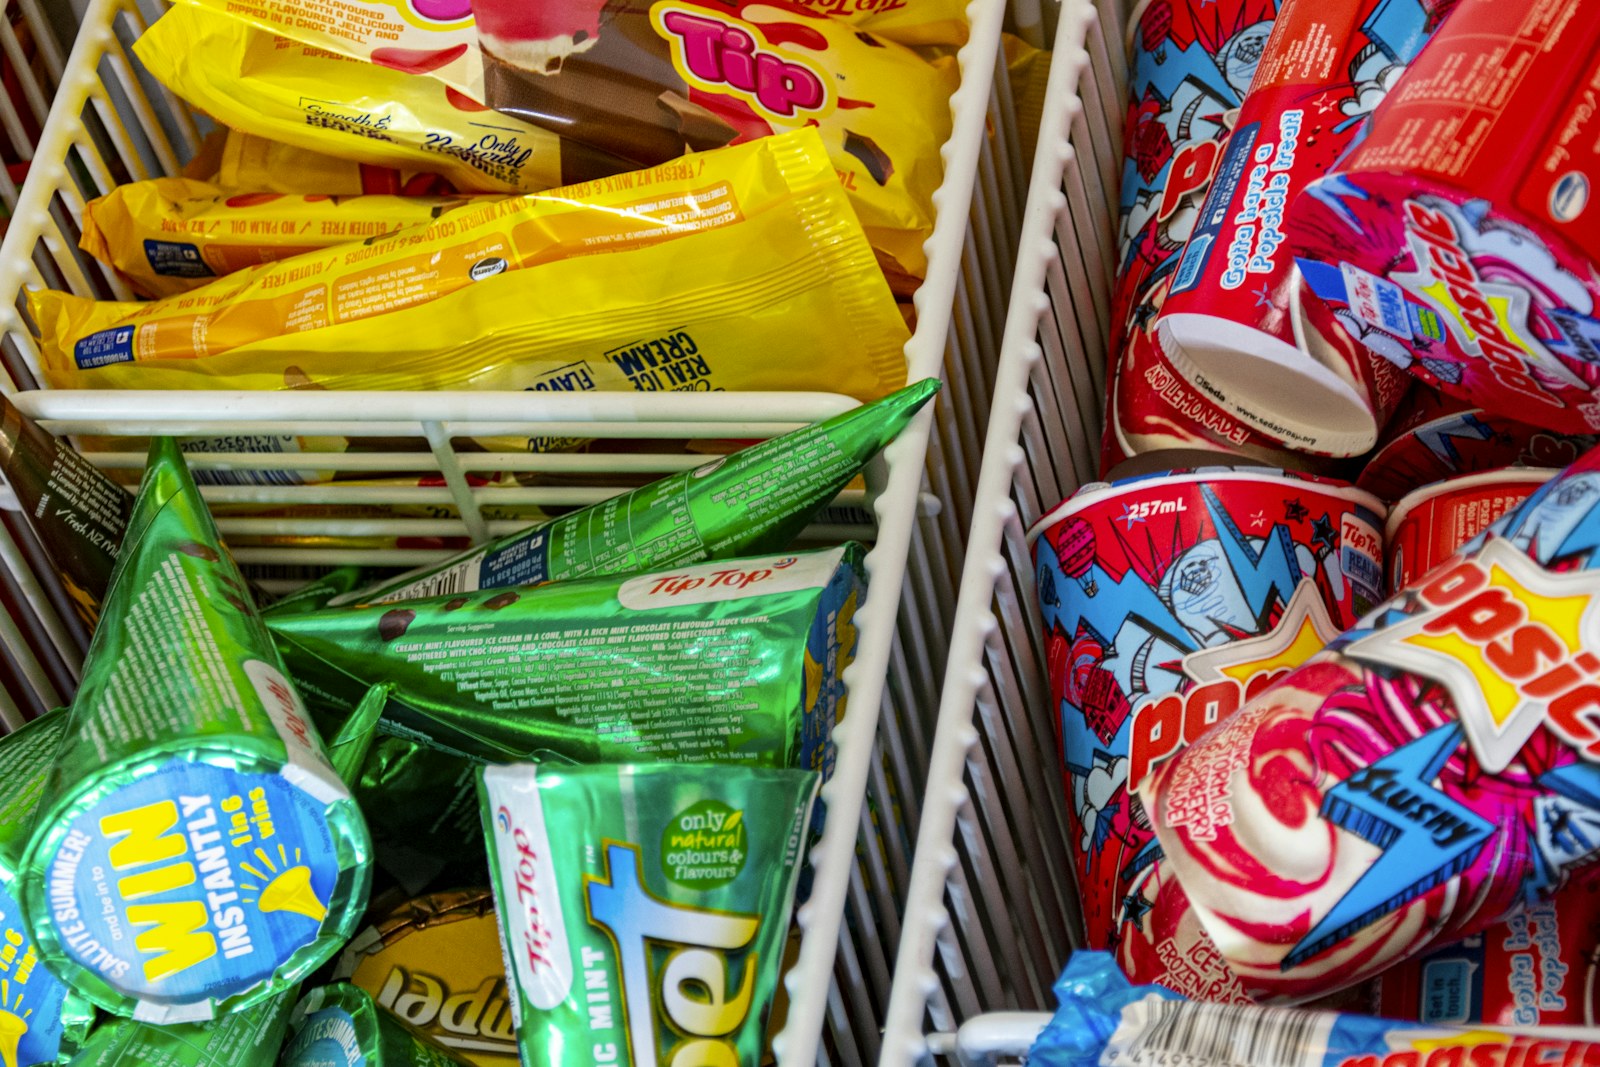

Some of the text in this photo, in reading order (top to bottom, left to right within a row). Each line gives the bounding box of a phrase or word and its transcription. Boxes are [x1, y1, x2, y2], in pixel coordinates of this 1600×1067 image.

[225, 1, 268, 20] DIPPED
[269, 13, 282, 23] IN
[284, 16, 292, 25] A
[296, 18, 326, 32] CHOC
[328, 26, 367, 44] SHELL.
[268, 1, 335, 25] FLAVOURED
[337, 19, 371, 36] JELLY
[375, 29, 399, 41] AND
[301, 1, 335, 17] WITH
[335, 9, 344, 18] A
[346, 13, 405, 32] DELICIOUS
[662, 10, 824, 118] Tip
[1299, 22, 1327, 79] Carbohydrate
[1318, 45, 1338, 80] Sodium
[479, 133, 520, 156] Only
[1255, 143, 1274, 163] a
[603, 173, 633, 193] MILK
[634, 170, 652, 187] NZ
[654, 162, 694, 183] FRESH
[591, 180, 602, 196] &
[1235, 162, 1267, 225] have
[230, 219, 294, 234] NO PALM OIL
[320, 220, 386, 236] GLUTEN FREE
[456, 206, 499, 233] NATURAL
[1249, 173, 1290, 274] Popsicle
[342, 239, 397, 265] FLAVOURS
[1220, 222, 1255, 290] Gotta
[259, 272, 288, 291] FREE
[287, 261, 324, 281] GLUTEN
[611, 331, 700, 378] CREAM
[630, 366, 661, 391] ICE
[660, 356, 712, 391] REAL
[1145, 363, 1251, 446] AND LEMONADE!
[1199, 380, 1228, 401] Seda
[1127, 496, 1188, 520] 257mL
[1456, 503, 1467, 537] quantity
[1466, 501, 1477, 537] per 100g
[63, 511, 90, 536] Fresh
[85, 528, 105, 547] NZ
[1338, 521, 1369, 549] Tip
[480, 575, 497, 588] 181
[647, 566, 773, 597] Tip Top
[394, 643, 422, 652] CREAMY
[423, 641, 442, 650] MINT
[443, 638, 482, 648] FLAVOURED
[497, 635, 522, 644] CREAM
[563, 630, 581, 639] WITH
[590, 627, 608, 636] RICH
[610, 626, 628, 634] MINT
[630, 623, 670, 633] CHOCOLATE
[673, 620, 714, 630] FLAVOURED
[445, 624, 467, 633] Serving
[407, 652, 447, 662] SMOTHERED
[449, 650, 467, 658] WITH
[469, 648, 486, 656] CHOC
[489, 645, 518, 654] TOPPING
[520, 643, 535, 651] AND
[537, 639, 576, 649] CHOCOLATE
[579, 638, 603, 646] COATED
[605, 635, 625, 643] MINT
[627, 632, 667, 642] FLAVOURED
[221, 795, 243, 813] 6
[248, 787, 276, 840] wins
[680, 810, 724, 834] only
[669, 829, 742, 850] natural
[666, 849, 744, 866] colours &
[673, 863, 738, 881] flavours
[100, 799, 218, 983] WIN
[179, 794, 254, 960] INSTANTLY
[52, 827, 130, 978] SALUTE SUMMER!
[513, 828, 555, 974] Tip Top
[6, 928, 24, 946] 6
[101, 914, 123, 941] and
[1155, 939, 1207, 990] FROZEN
[1524, 906, 1570, 1010] Popsicl
[580, 947, 606, 1031] MINT
[1506, 952, 1541, 1025] Gotta
